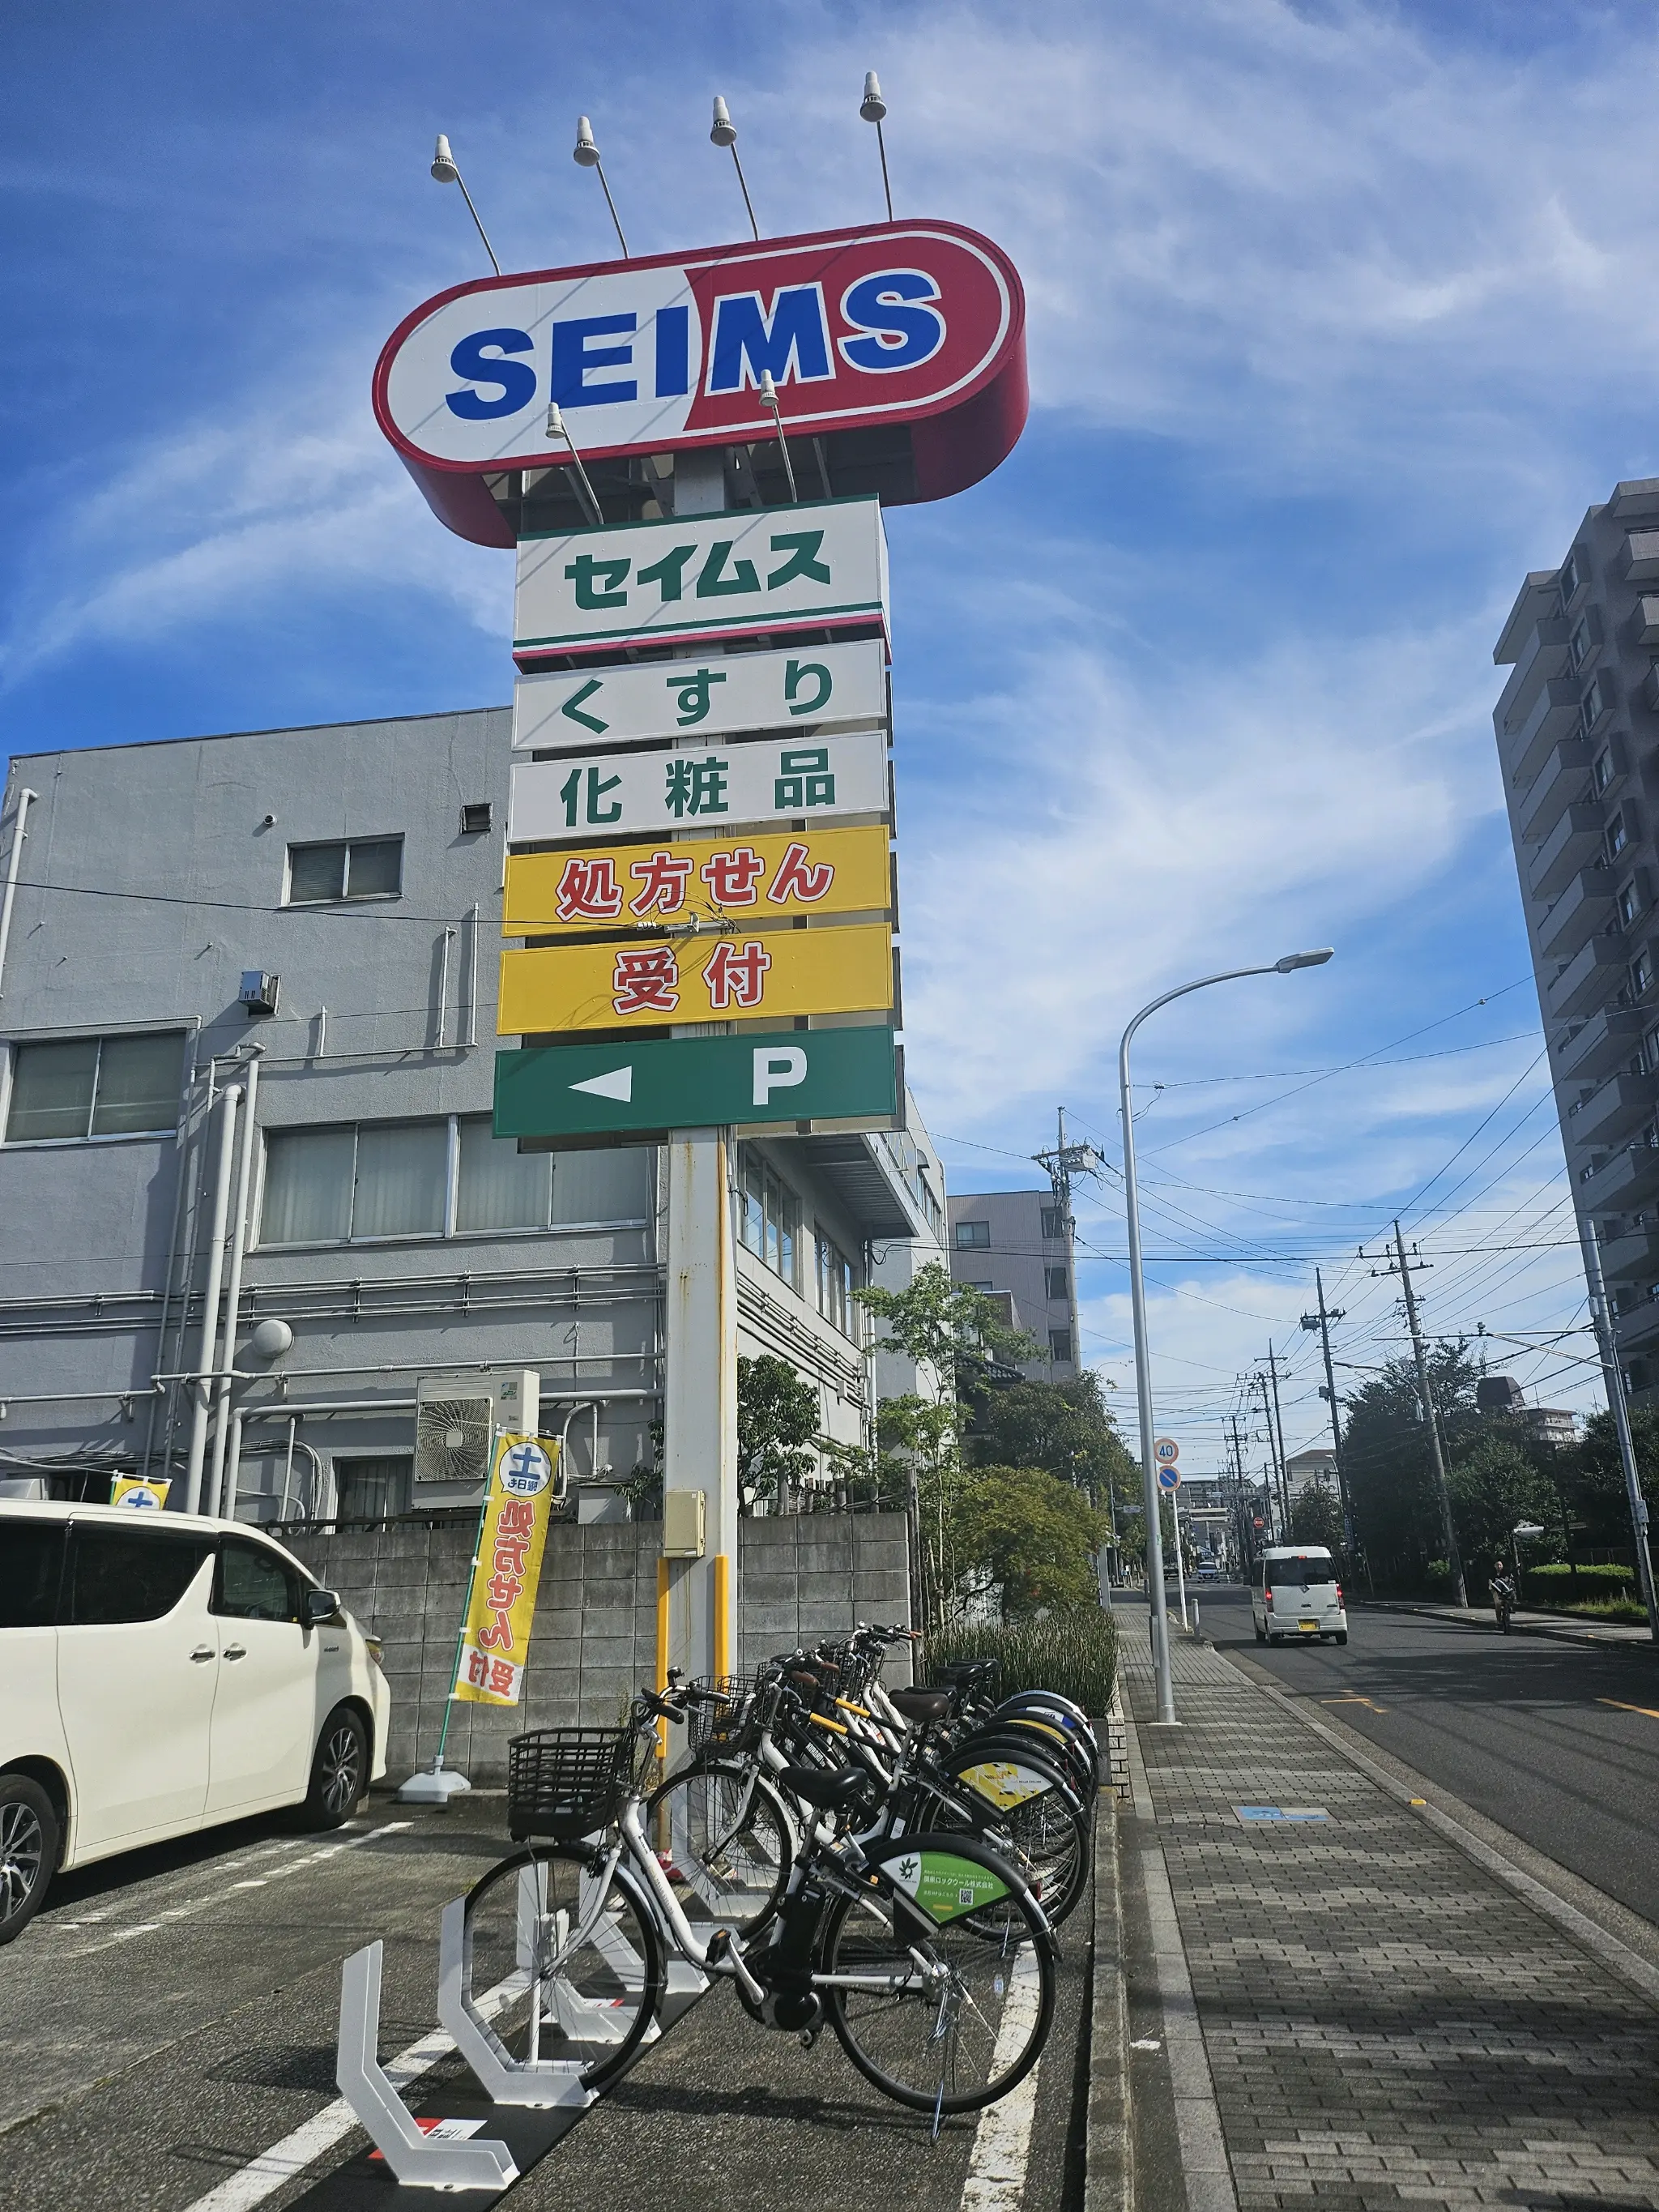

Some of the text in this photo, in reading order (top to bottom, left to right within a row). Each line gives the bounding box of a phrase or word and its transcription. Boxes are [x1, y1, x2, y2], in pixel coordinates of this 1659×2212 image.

[445, 268, 947, 421] SEIMS
[565, 529, 831, 611] セイムス
[561, 659, 834, 734] くすり
[560, 748, 836, 827] 化粧品
[555, 842, 836, 922] 処方せん
[613, 942, 772, 1015] 受付
[753, 1046, 808, 1106] P
[1159, 1445, 1173, 1457] 40
